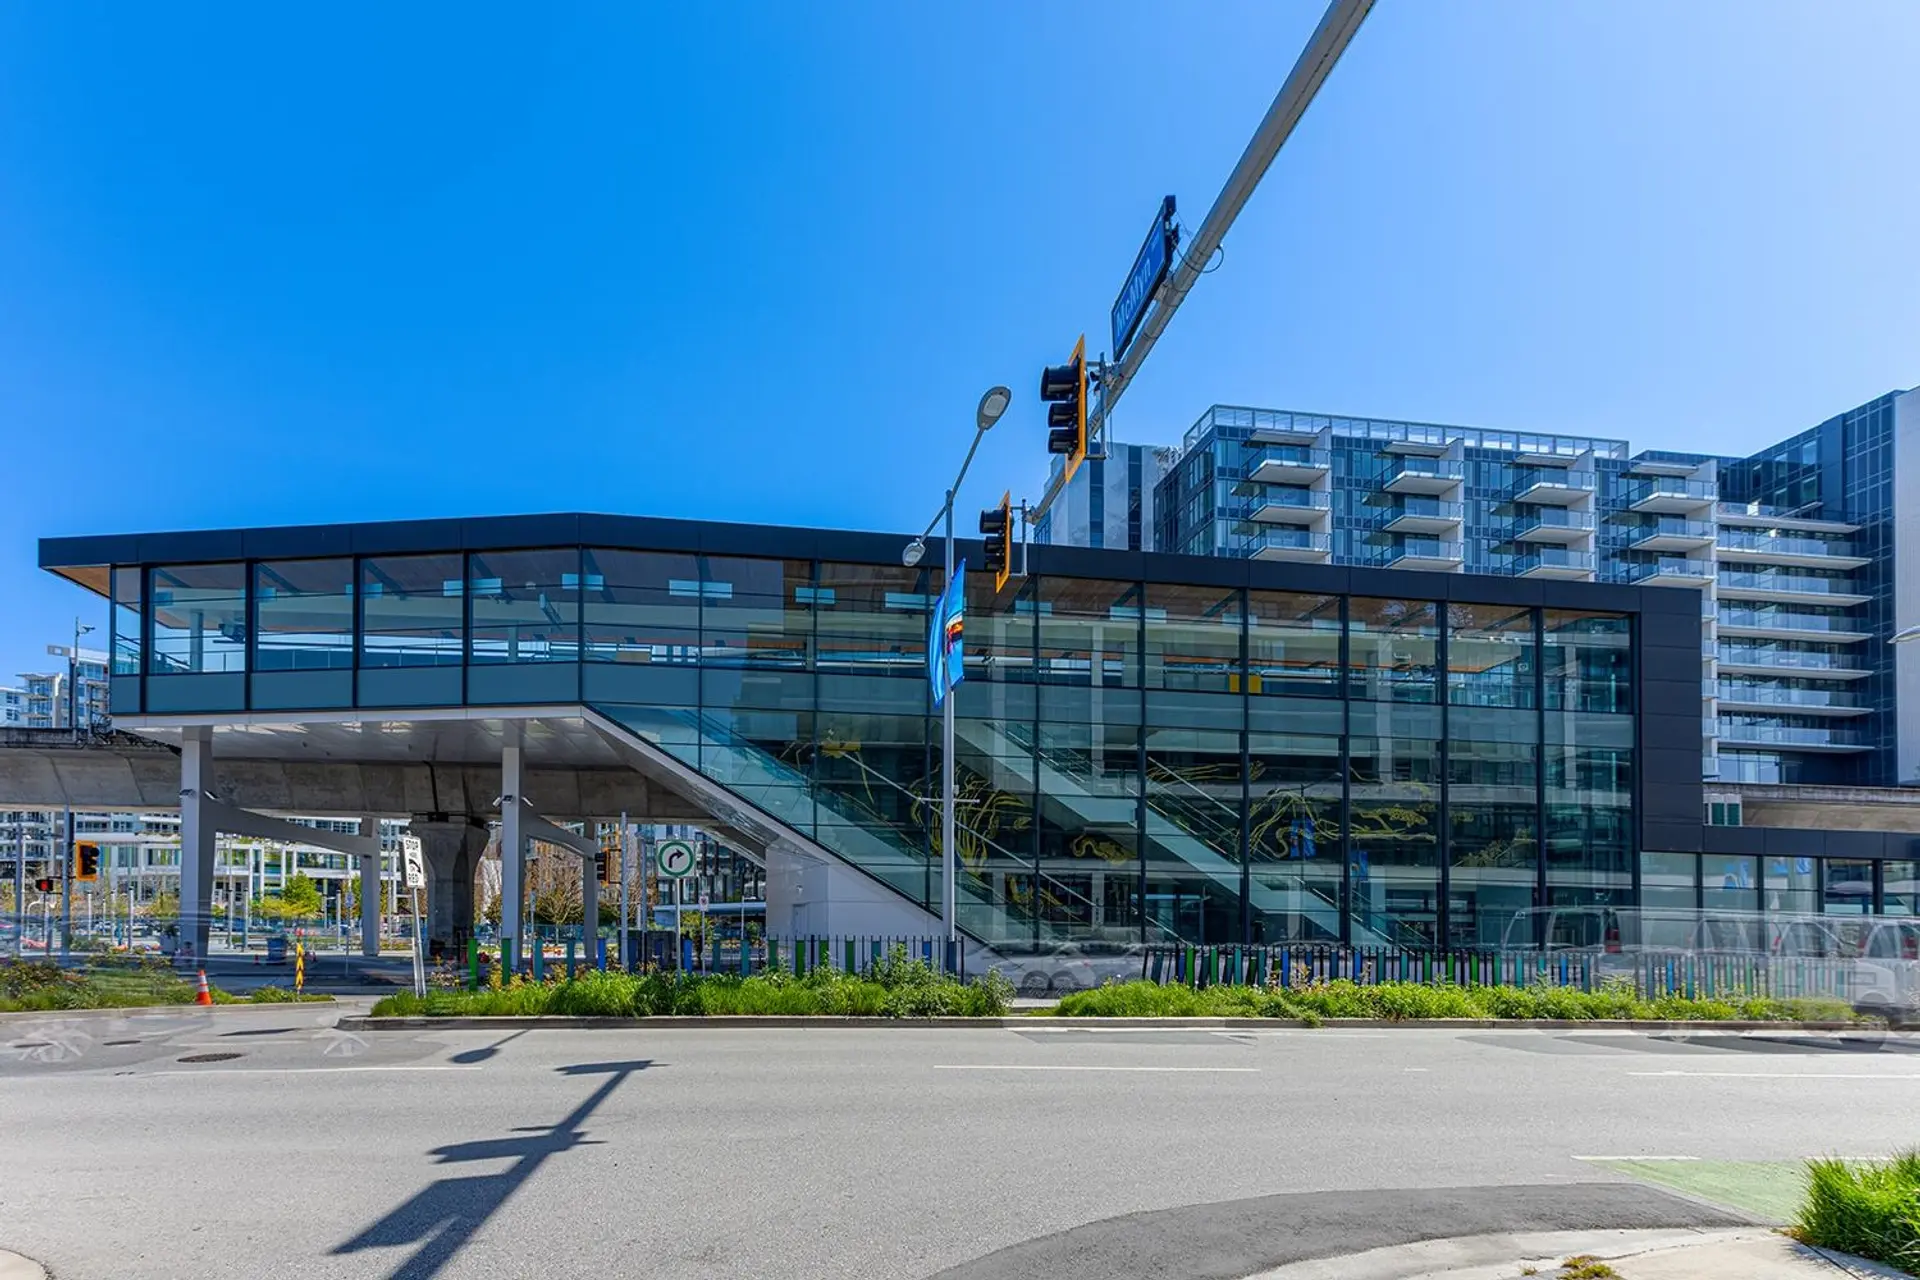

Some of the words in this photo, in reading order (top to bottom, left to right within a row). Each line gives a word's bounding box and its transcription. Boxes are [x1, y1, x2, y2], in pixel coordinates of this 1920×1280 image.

[1116, 257, 1151, 337] McMyn
[405, 839, 419, 850] STOP
[408, 873, 420, 884] RED
